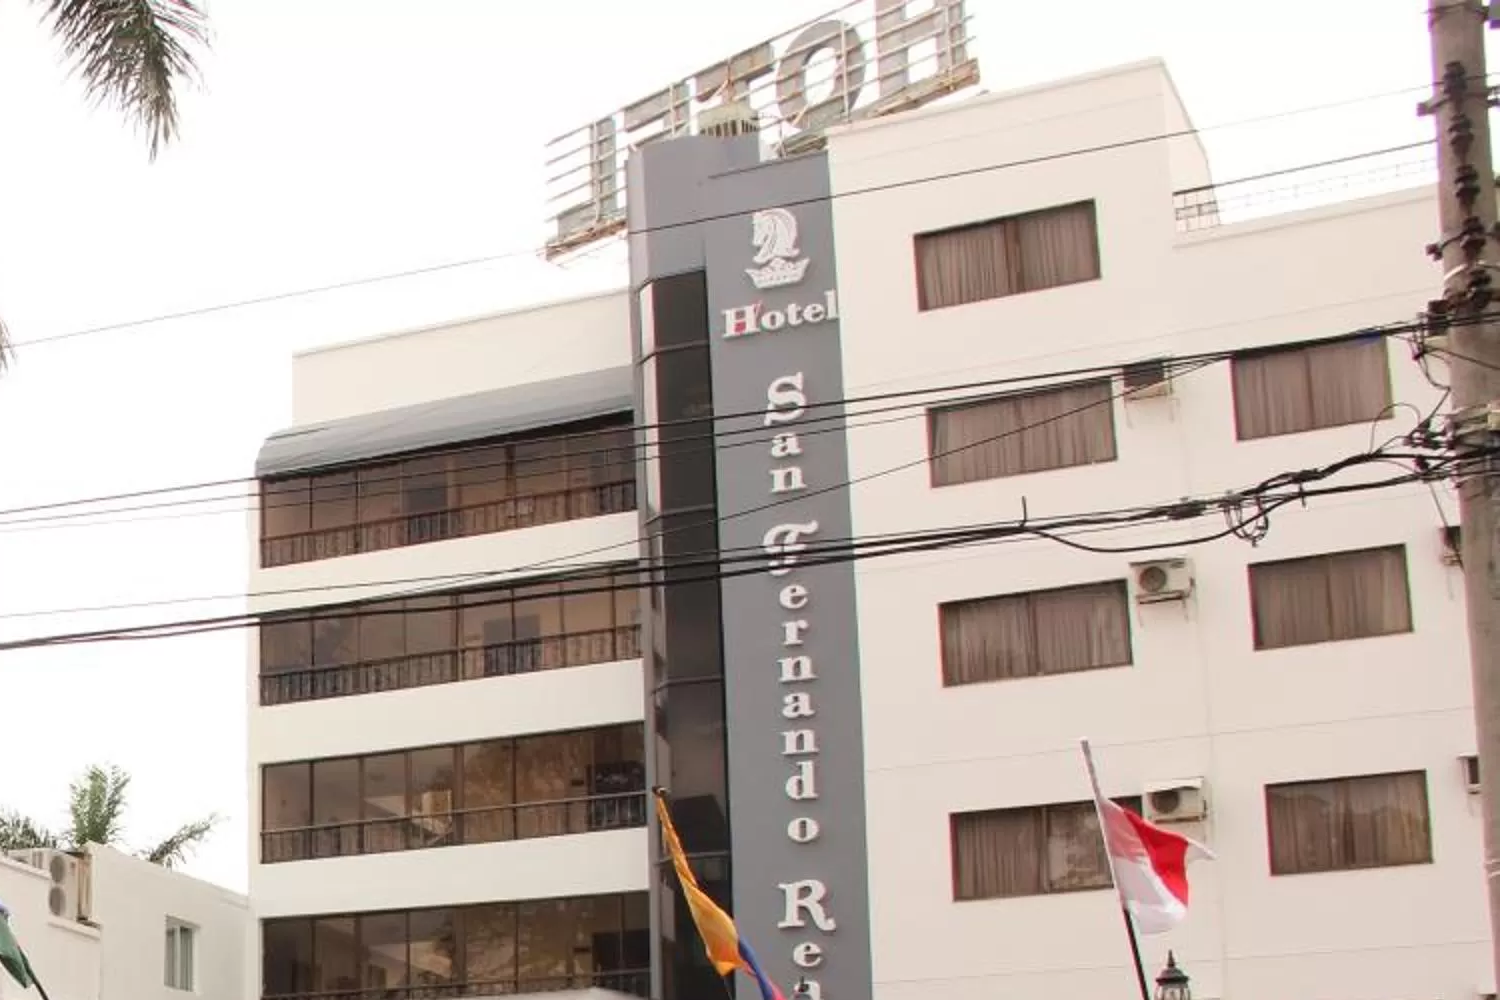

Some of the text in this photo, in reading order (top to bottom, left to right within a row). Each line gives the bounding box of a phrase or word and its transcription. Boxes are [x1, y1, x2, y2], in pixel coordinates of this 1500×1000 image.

[721, 289, 839, 338] Hotel
[763, 371, 808, 494] San
[762, 519, 820, 843] Fernando
